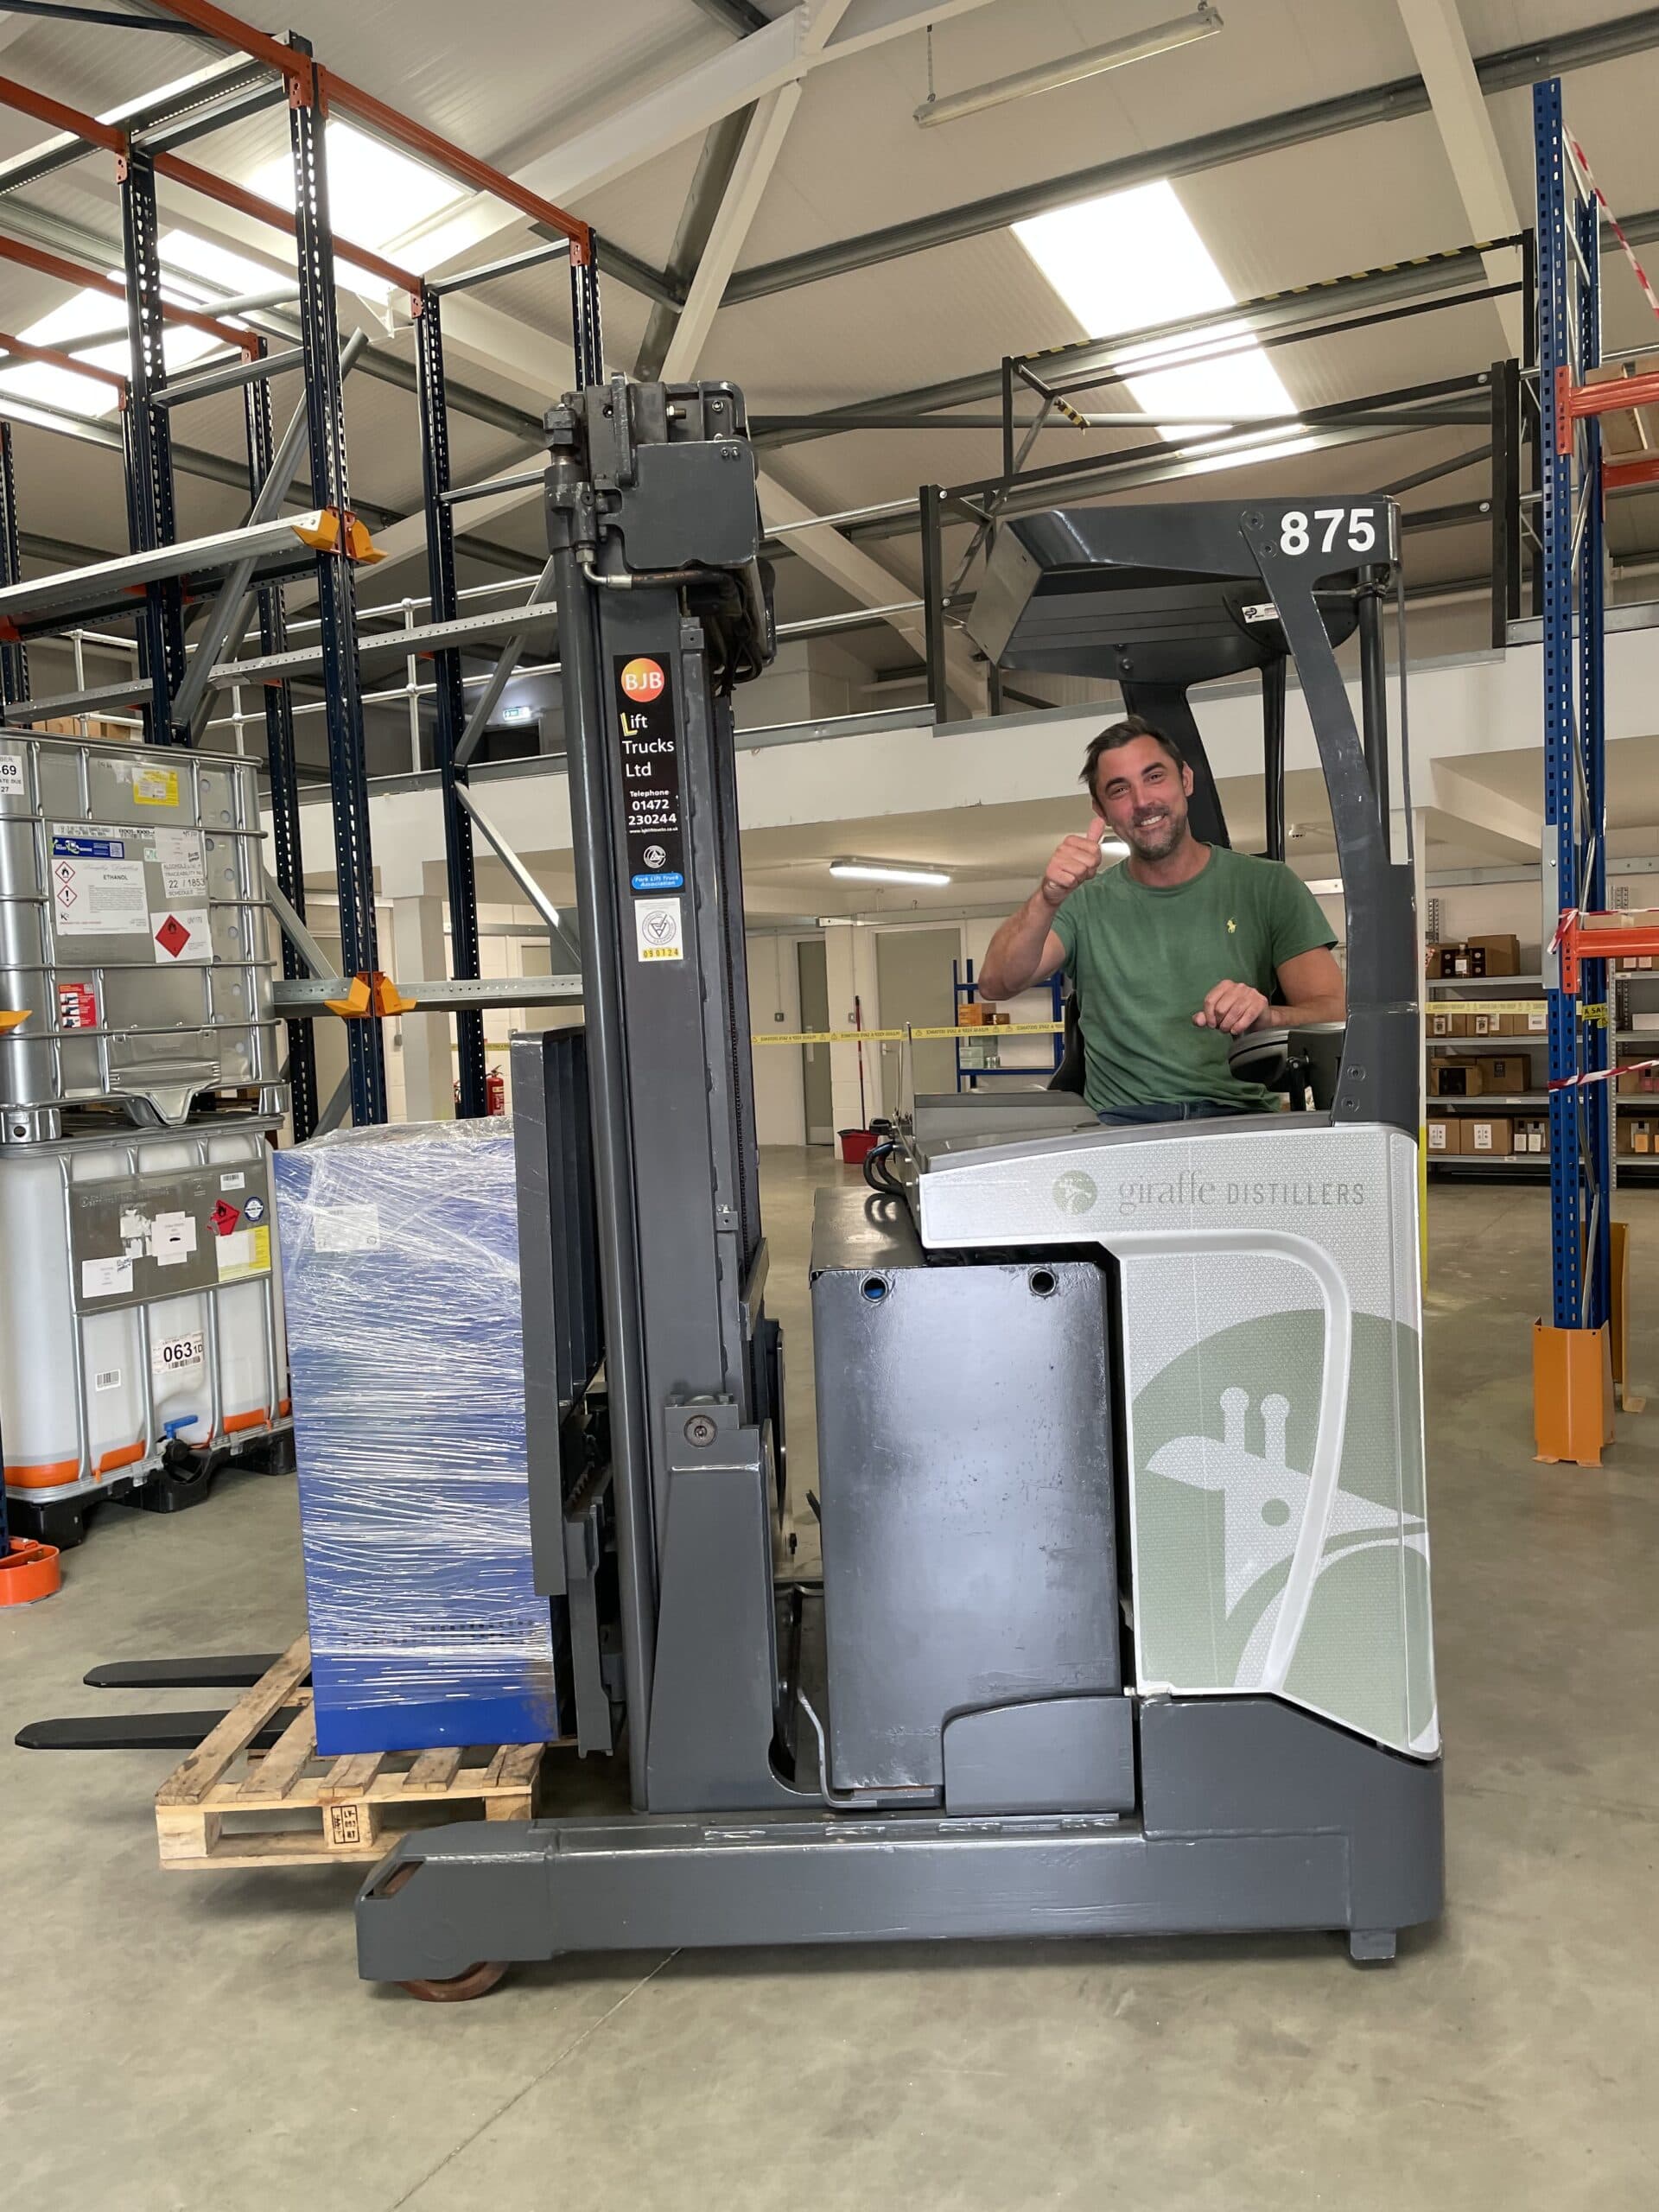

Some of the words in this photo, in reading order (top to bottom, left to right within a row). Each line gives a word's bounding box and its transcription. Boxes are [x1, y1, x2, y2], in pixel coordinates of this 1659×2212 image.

[1280, 508, 1376, 556] 875
[625, 671, 663, 691] BJB
[620, 711, 648, 737] Lift
[621, 737, 675, 754] Trucks
[625, 761, 652, 778] Ltd
[629, 789, 670, 798] Telephone
[632, 798, 670, 810] 01472
[628, 812, 677, 826] 230244
[168, 880, 179, 888] 22
[1119, 1169, 1215, 1215] giraffe
[1227, 1182, 1364, 1205] DISTILLERS
[163, 1341, 193, 1363] 063
